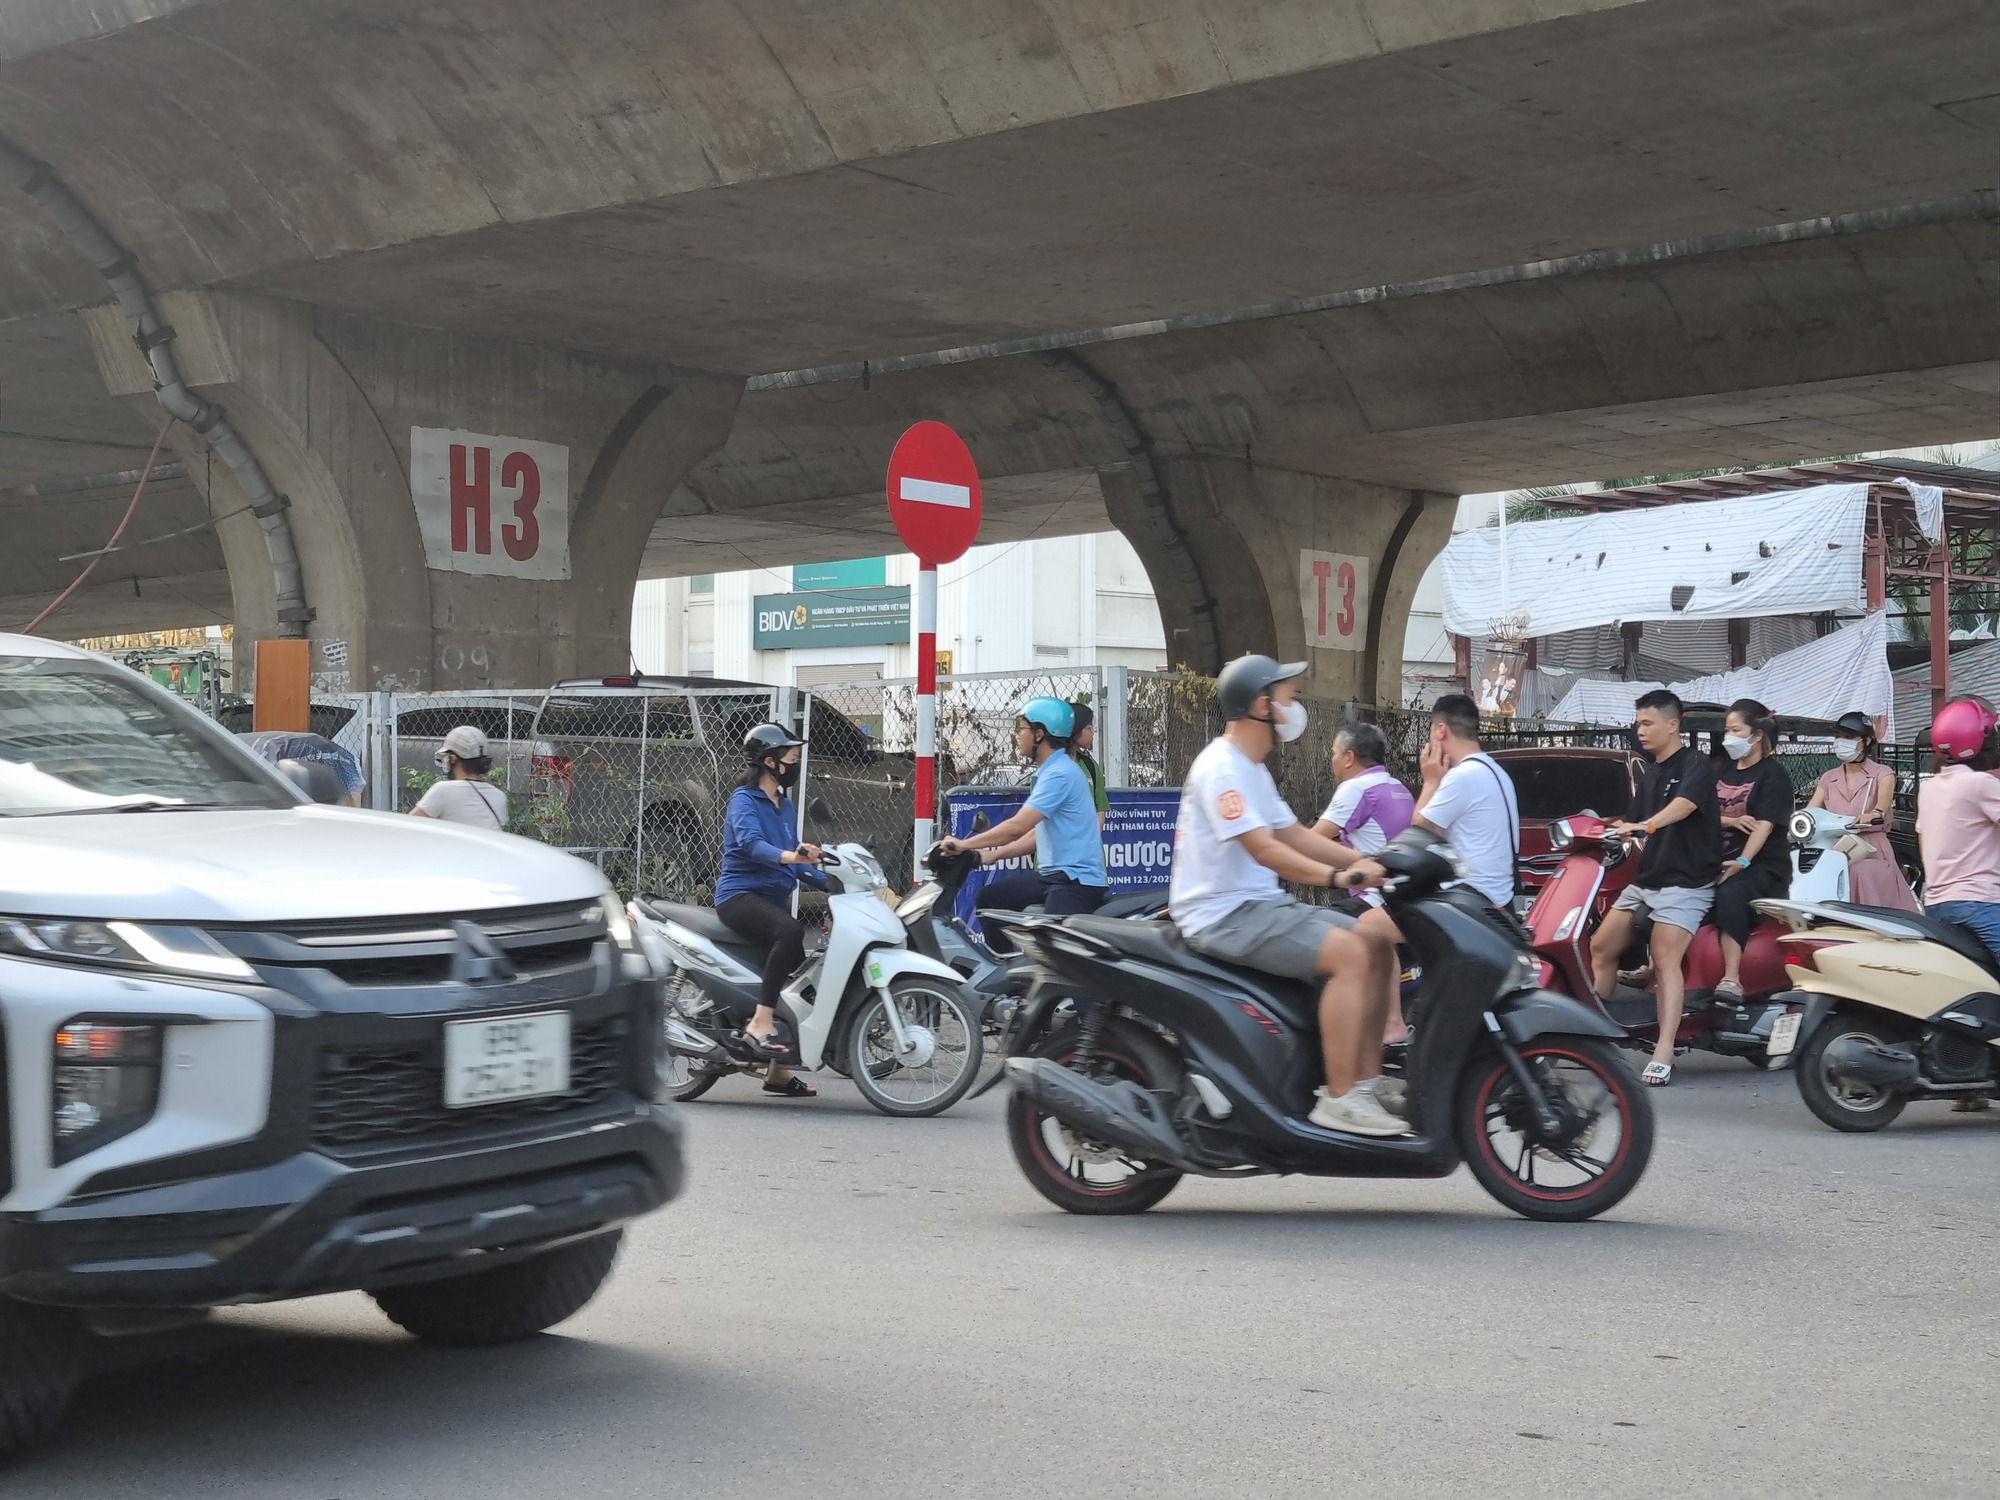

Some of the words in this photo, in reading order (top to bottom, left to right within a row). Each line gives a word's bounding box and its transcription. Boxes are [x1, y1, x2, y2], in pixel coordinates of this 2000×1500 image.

[449, 444, 541, 561] H3
[1313, 560, 1356, 636] T3
[759, 610, 795, 632] BIDV
[1129, 808, 1150, 818] VĨNH
[1151, 810, 1167, 818] TUY
[1121, 822, 1145, 831] THAM
[1145, 822, 1160, 830] GIA
